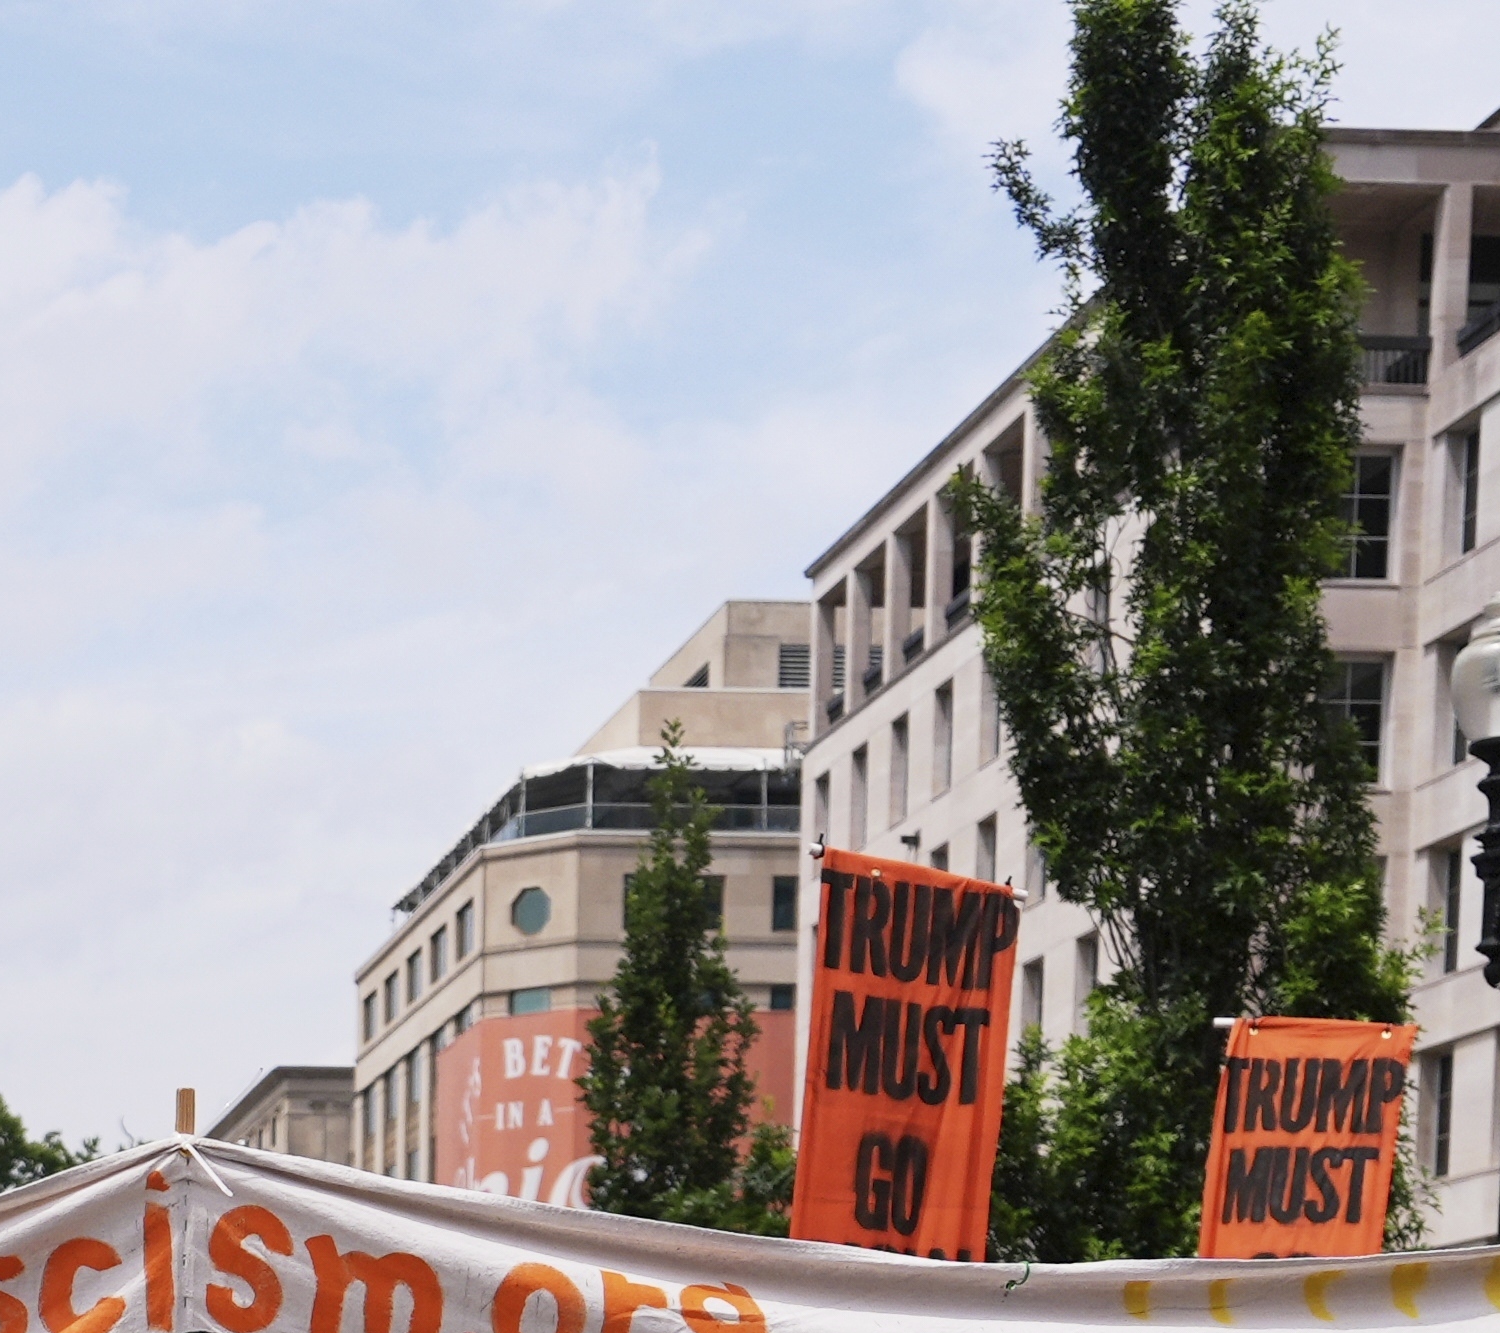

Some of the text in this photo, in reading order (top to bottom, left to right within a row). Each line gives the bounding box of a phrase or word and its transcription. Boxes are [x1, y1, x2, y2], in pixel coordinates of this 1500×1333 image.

[820, 868, 1020, 991] TRUMP
[826, 989, 990, 1106] MUST
[495, 1098, 554, 1130] IN A
[1224, 1056, 1407, 1134] TRUMP
[854, 1131, 928, 1236] GO
[1221, 1146, 1379, 1225] MUST
